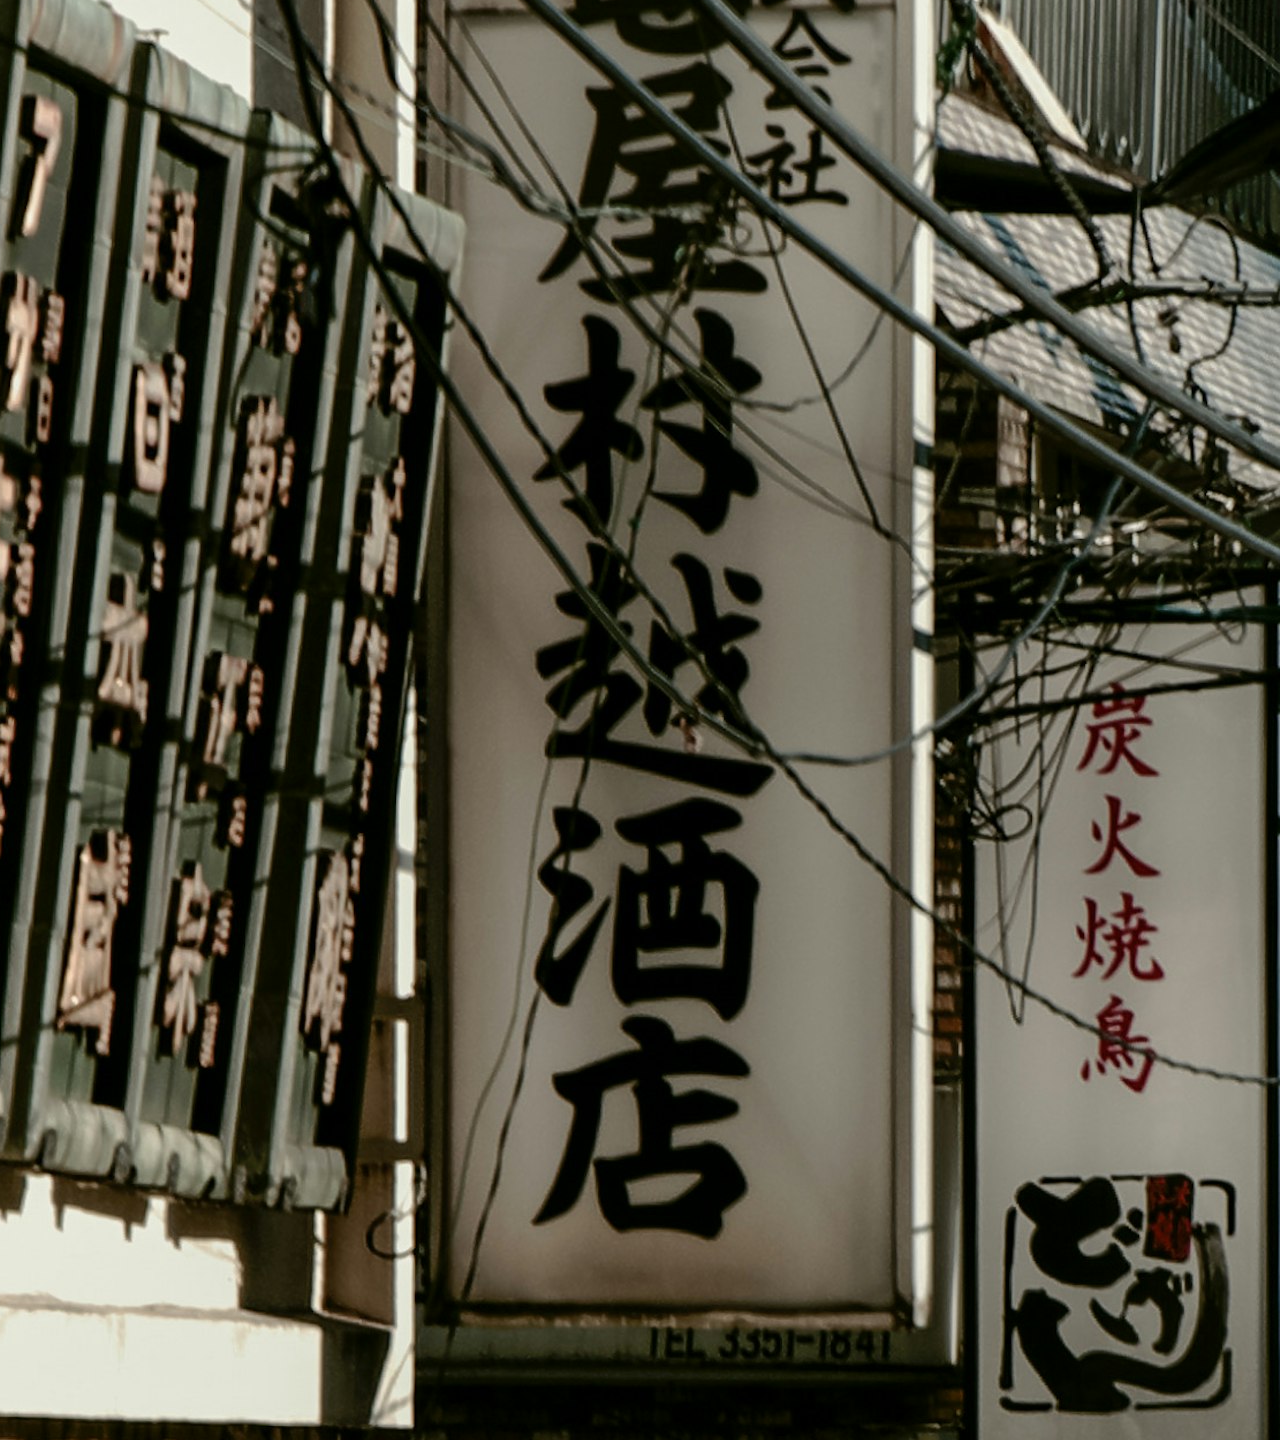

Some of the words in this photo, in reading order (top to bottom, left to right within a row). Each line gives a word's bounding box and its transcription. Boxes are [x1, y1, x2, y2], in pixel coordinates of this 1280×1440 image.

[1072, 682, 1164, 1095] 炭火焼鳥
[648, 1326, 707, 1359] TEL
[718, 1327, 891, 1360] 3351-1841
